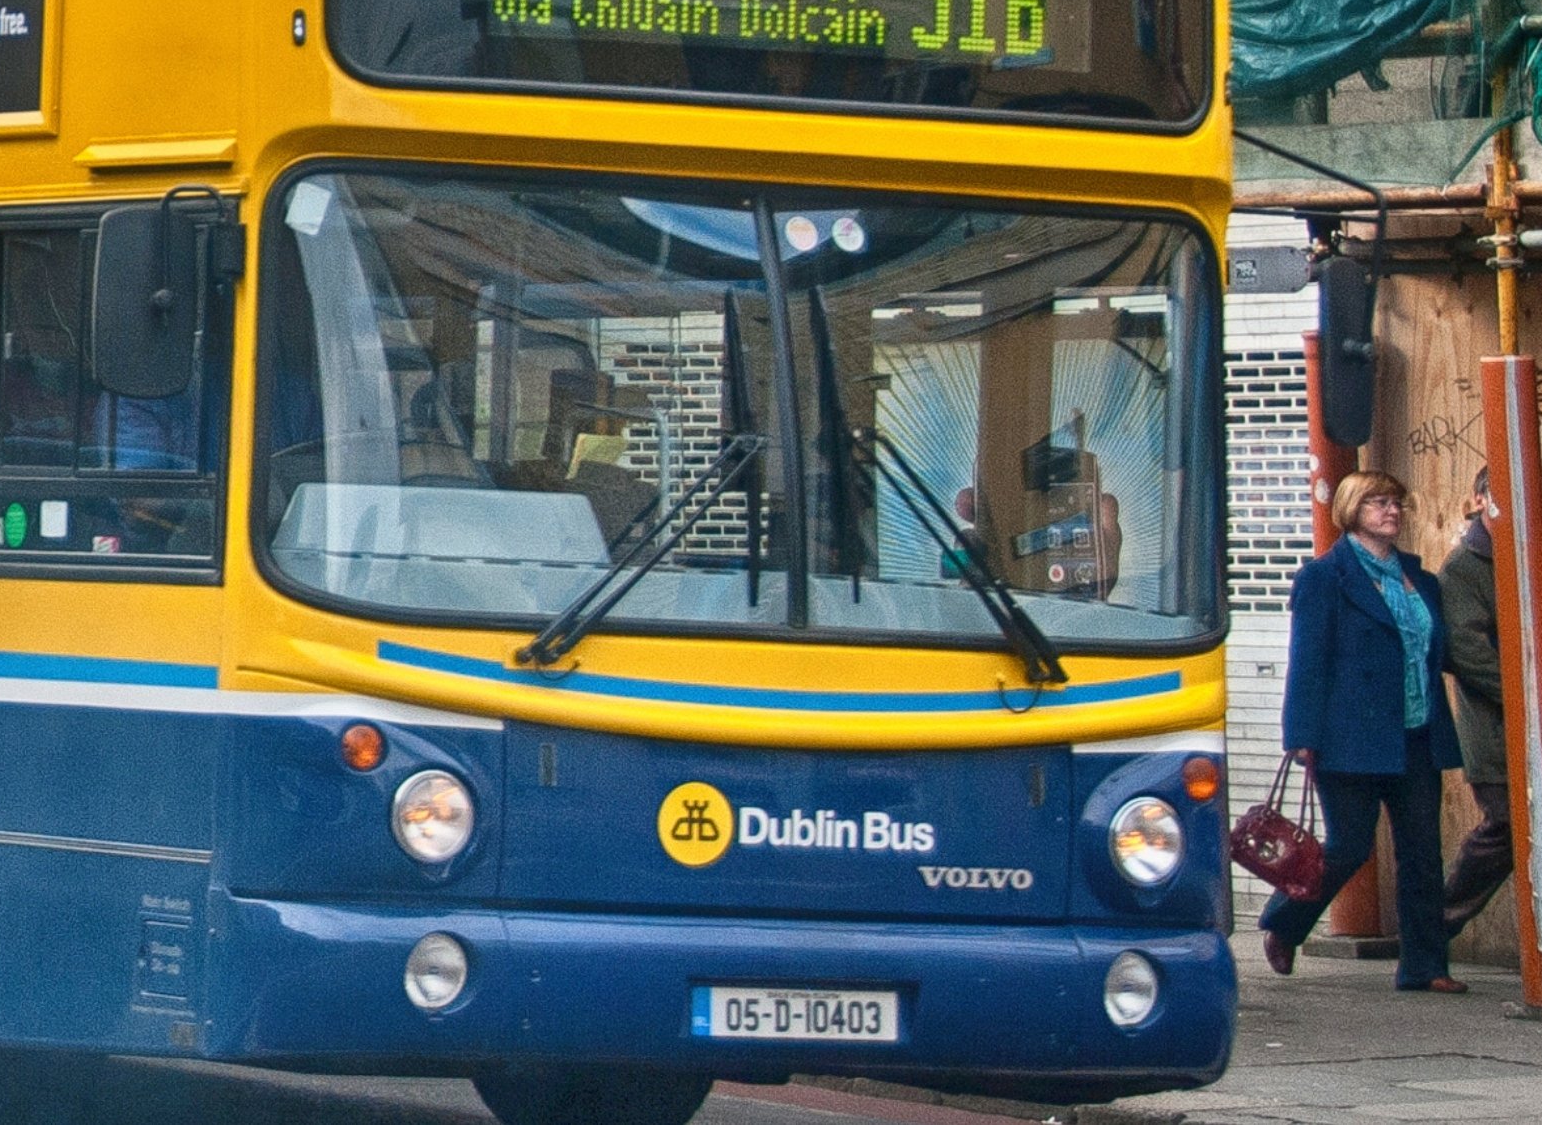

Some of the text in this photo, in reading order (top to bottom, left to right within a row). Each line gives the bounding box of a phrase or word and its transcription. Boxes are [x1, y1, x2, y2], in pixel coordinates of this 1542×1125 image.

[0, 6, 28, 35] free.
[738, 806, 935, 852] Dublin Bus
[919, 866, 1034, 890] VOLVO
[726, 998, 881, 1034] 05-D-10403
